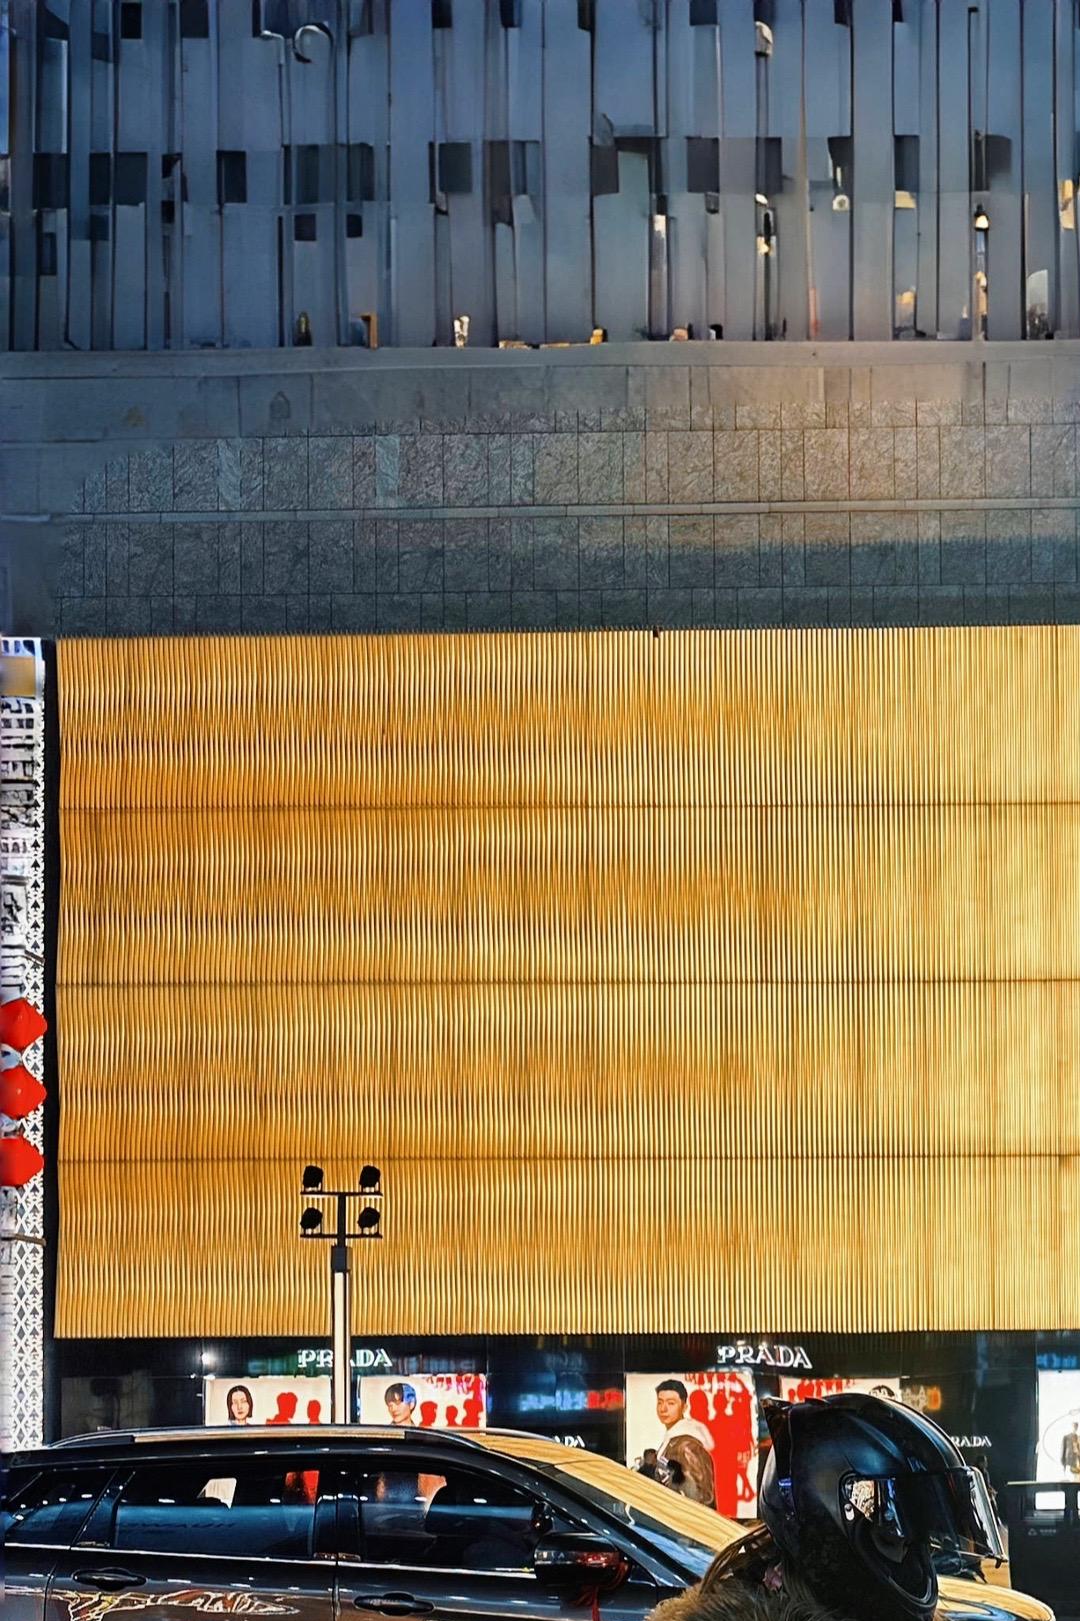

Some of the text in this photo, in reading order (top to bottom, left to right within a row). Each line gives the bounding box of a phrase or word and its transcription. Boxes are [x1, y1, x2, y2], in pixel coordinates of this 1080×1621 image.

[297, 1347, 393, 1368] PRDA
[717, 1344, 813, 1369] PRADA
[950, 1435, 992, 1448] RADA
